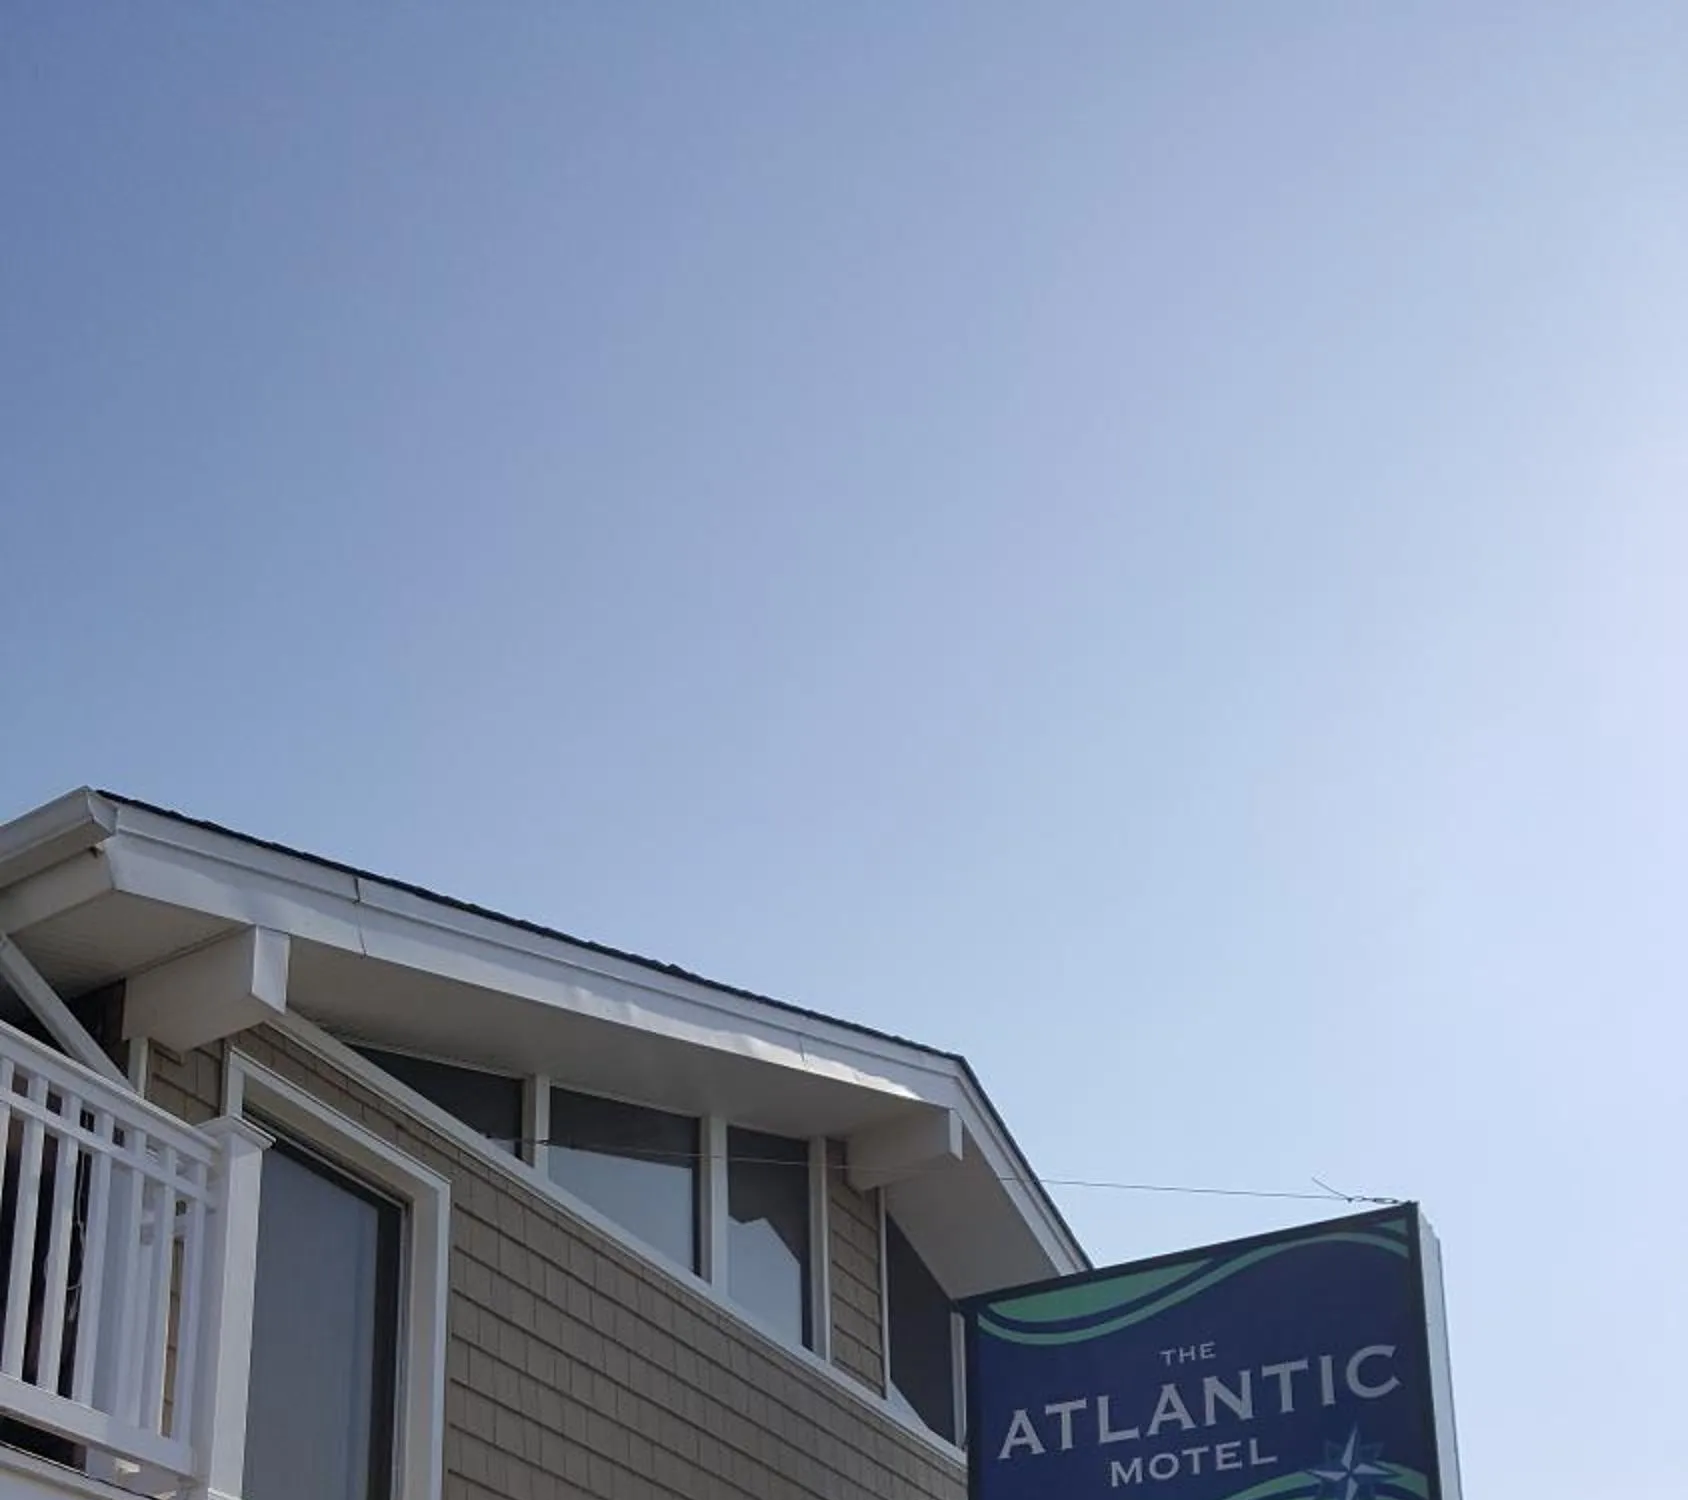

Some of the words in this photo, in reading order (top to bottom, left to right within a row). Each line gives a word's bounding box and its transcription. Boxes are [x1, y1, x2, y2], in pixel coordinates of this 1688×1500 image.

[1160, 1340, 1217, 1366] THE
[998, 1344, 1402, 1460] ATLANTIC
[1109, 1436, 1279, 1488] MOTEL
